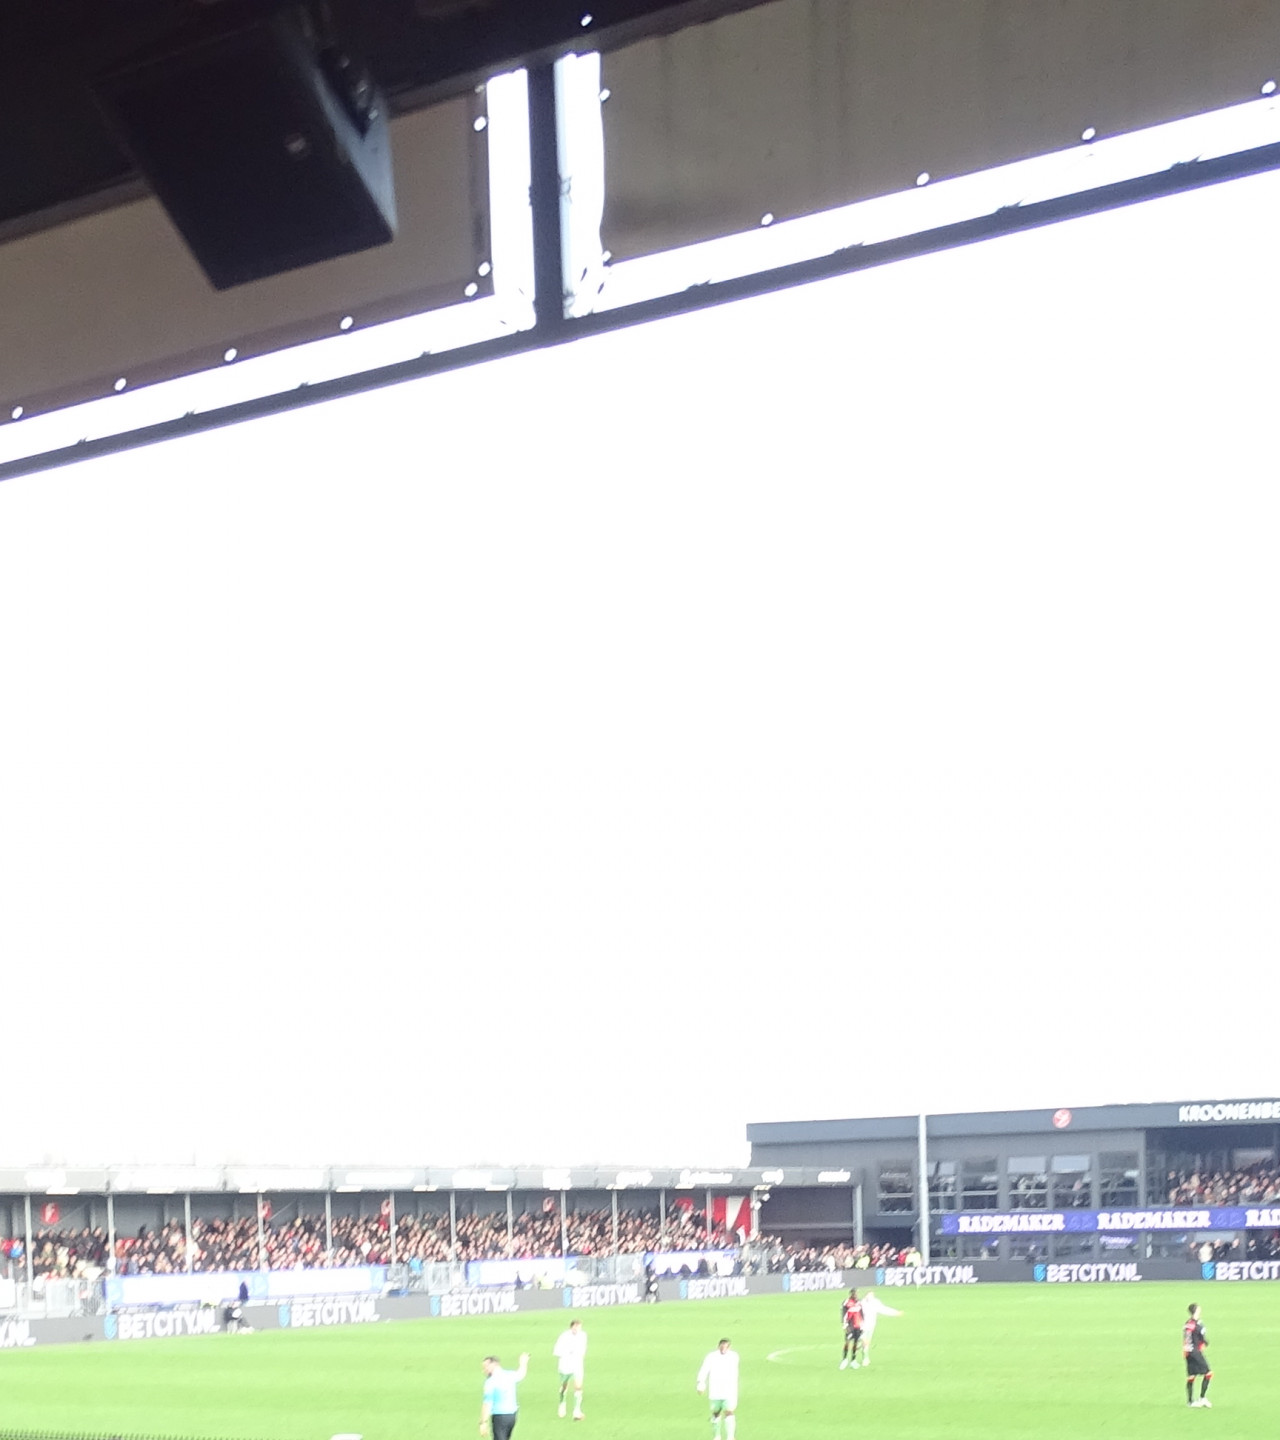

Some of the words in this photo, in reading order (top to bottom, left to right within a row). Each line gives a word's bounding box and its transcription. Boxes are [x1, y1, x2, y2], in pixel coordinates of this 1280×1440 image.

[957, 1213, 1066, 1233] RADEMAKER
[1096, 1210, 1212, 1230] RADEMAKER
[884, 1265, 979, 1287] BETCITY.NL
[1046, 1262, 1143, 1282] BETCITY.NL
[116, 1307, 221, 1340] BETCITY.NL
